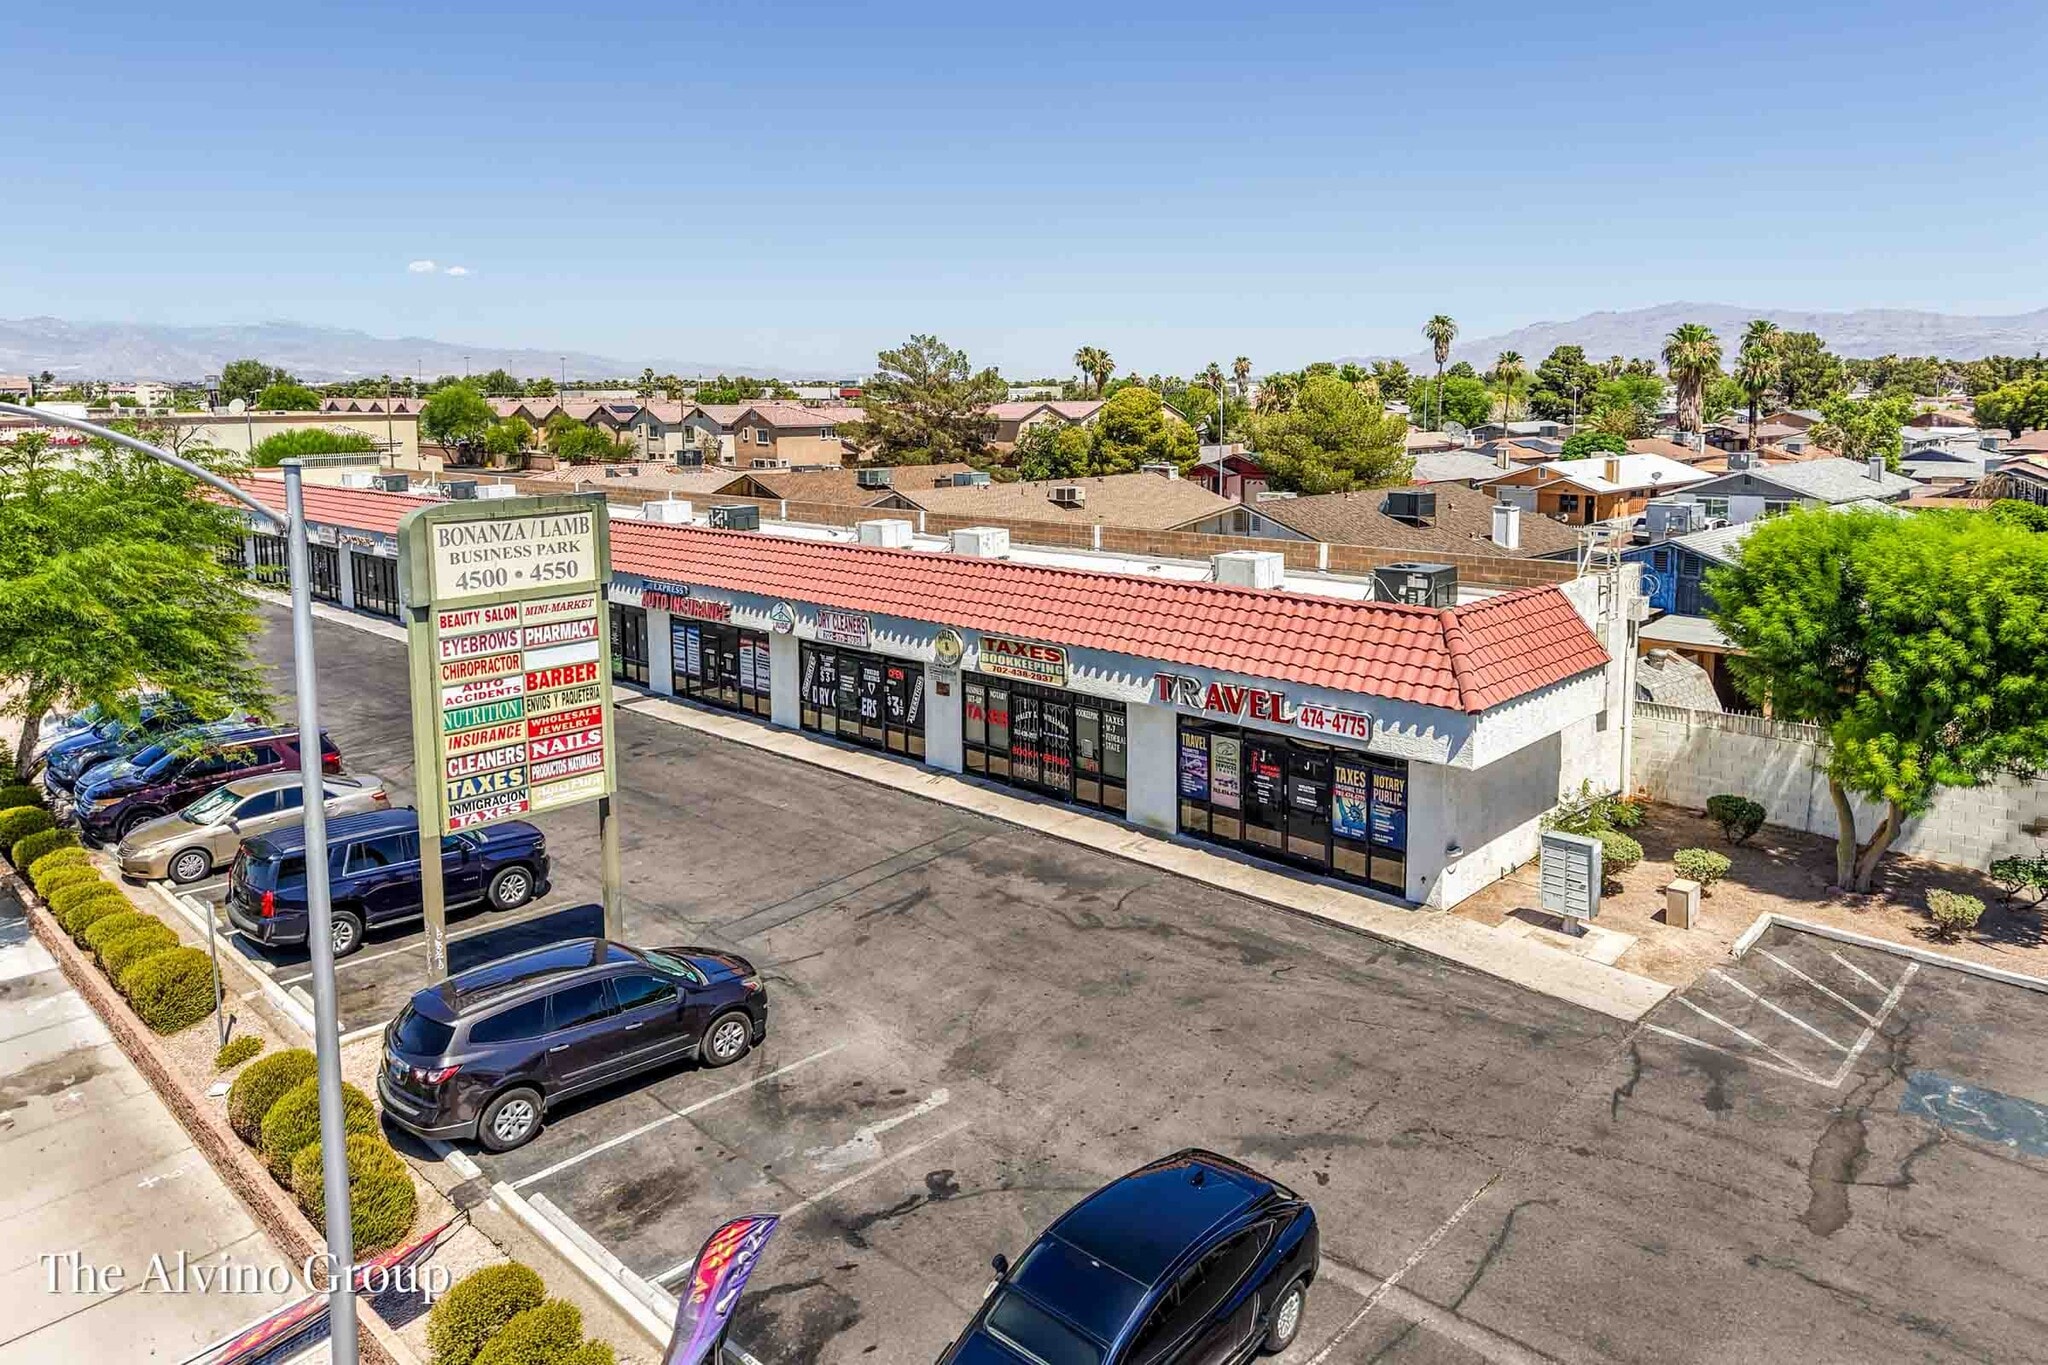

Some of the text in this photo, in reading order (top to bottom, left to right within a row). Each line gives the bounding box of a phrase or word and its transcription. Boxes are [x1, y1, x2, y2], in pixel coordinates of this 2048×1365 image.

[439, 522, 526, 547] BONANZA
[540, 516, 590, 538] LAMB
[450, 541, 581, 565] BUSINESS PARK
[456, 560, 578, 590] 4500 4550
[653, 583, 684, 595] EXPRESS
[440, 606, 517, 629] BEAUTY SALON
[525, 598, 594, 616] MINI-MARKET
[442, 630, 519, 657] EYEBROWS
[526, 620, 597, 644] PHARMACY
[985, 637, 1061, 663] TAXES
[443, 654, 519, 681] CHIROPRACTOR
[981, 653, 1063, 675] BOOKKEEPING
[991, 665, 1054, 683] 702-438-2937
[462, 679, 504, 693] AUTO
[526, 663, 597, 691] BARBER
[445, 685, 521, 706] ACCIDENTS
[527, 686, 600, 712] ENVIOS Y PAQUETERIA
[1155, 673, 1291, 724] TRAVEL
[443, 701, 518, 730] NUTRITION
[531, 707, 599, 727] WHOLESALE
[539, 718, 590, 736] JEWELRY
[1105, 714, 1124, 726] TAXES
[1301, 708, 1366, 737] 474-4775
[449, 723, 522, 750] INSURANCE
[532, 729, 601, 758] NAILS
[1182, 733, 1207, 750] TRAVEL
[448, 745, 525, 776] CLEANERS
[531, 759, 567, 780] PRODUCTOS
[448, 769, 523, 800] TAXES
[1335, 766, 1366, 788] TAXES
[1373, 774, 1405, 792] NOTARY
[450, 790, 526, 816] INMIGRACION
[1373, 788, 1402, 806] PUBLIC
[456, 802, 522, 827] TAXES
